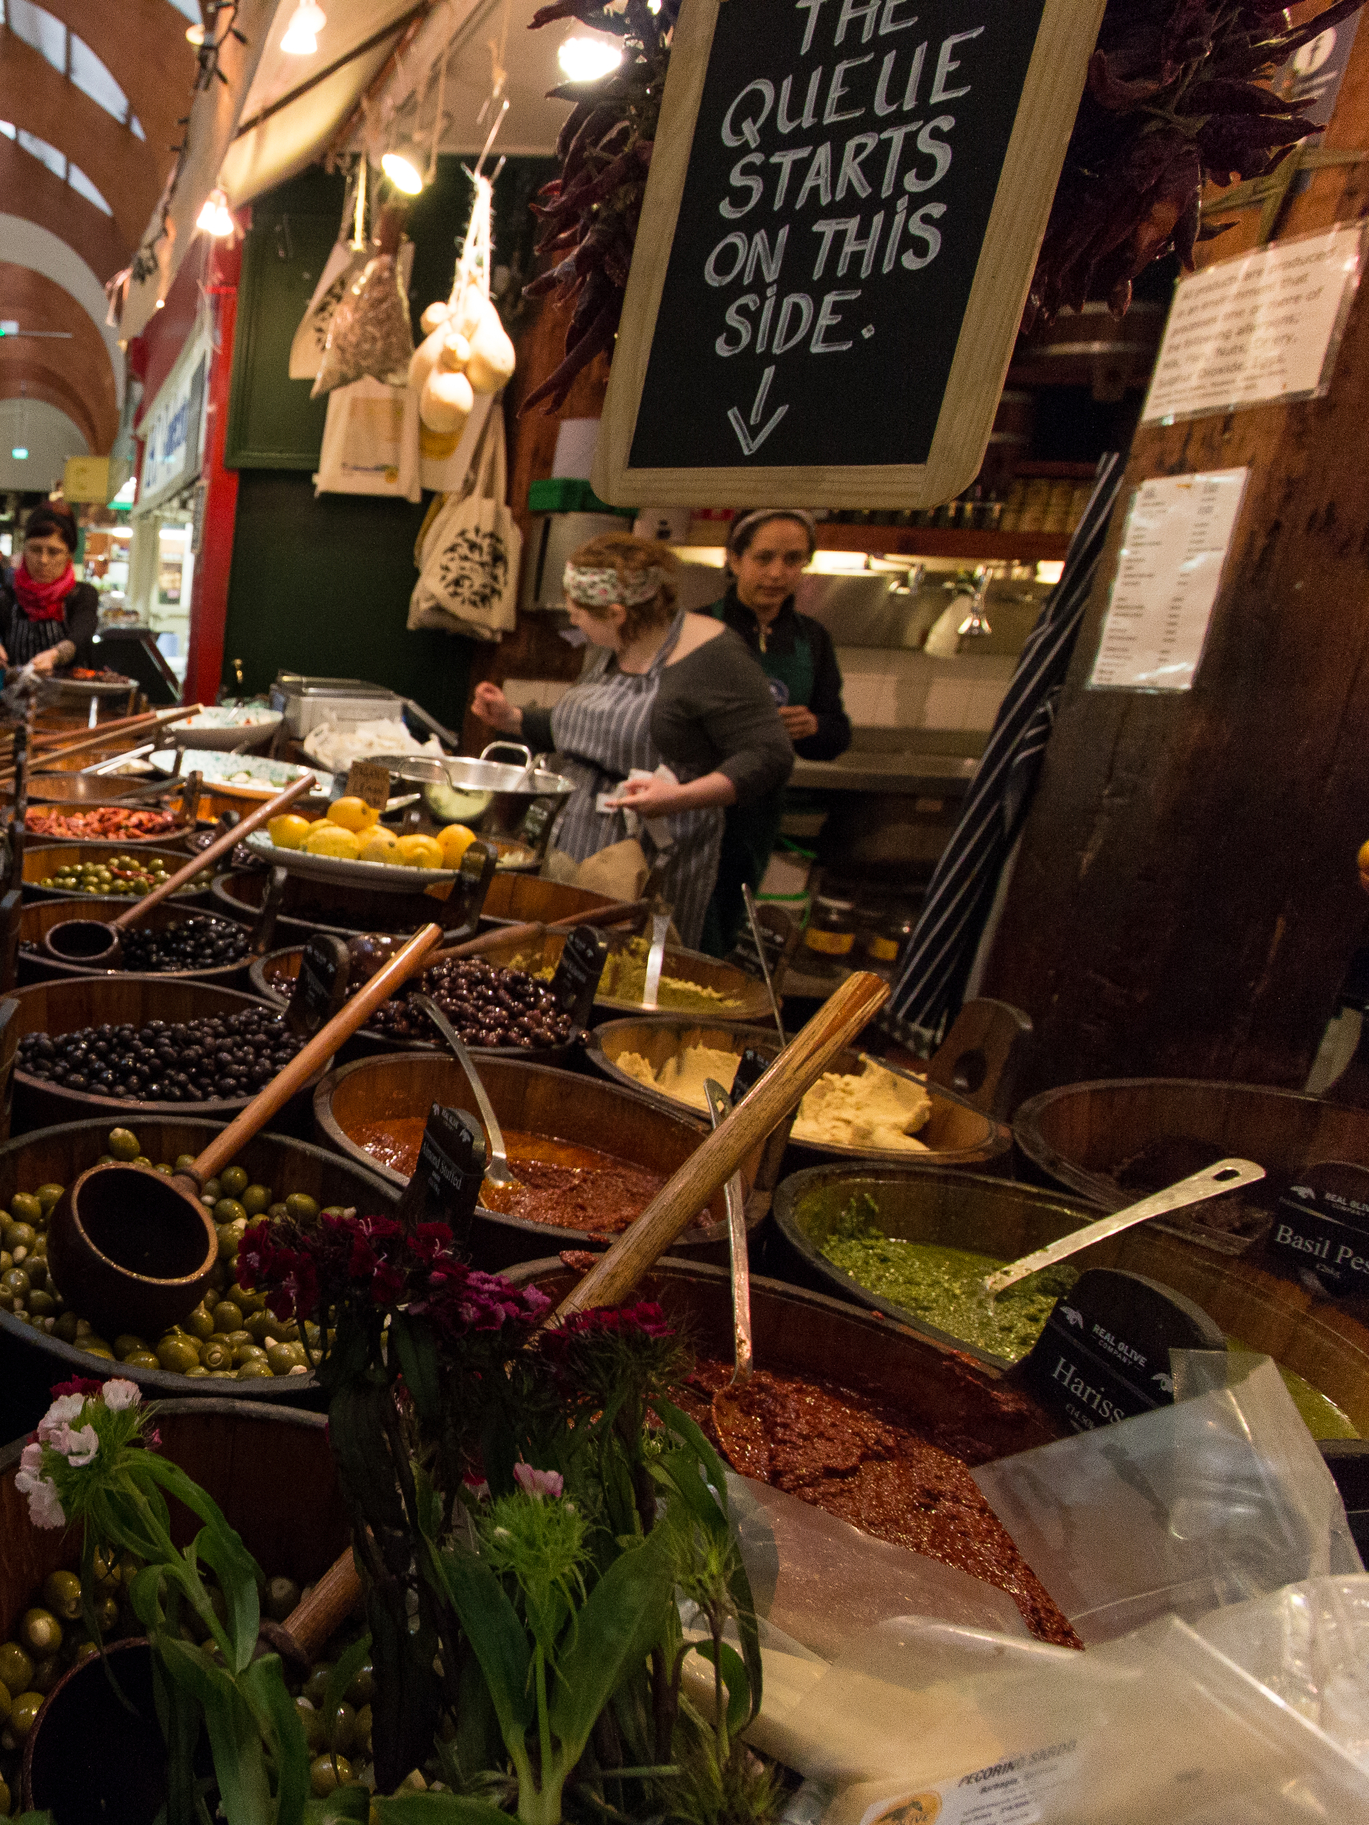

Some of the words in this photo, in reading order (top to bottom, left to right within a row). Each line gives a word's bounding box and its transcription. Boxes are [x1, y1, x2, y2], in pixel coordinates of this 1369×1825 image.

[721, 26, 985, 149] QUEUE
[719, 115, 956, 219] STARTS
[704, 224, 790, 288] ON
[1275, 1223, 1330, 1259] Basil
[1092, 1323, 1116, 1346] REAL
[1117, 1341, 1147, 1367] OLIVE
[1098, 1339, 1133, 1365] COMPANY
